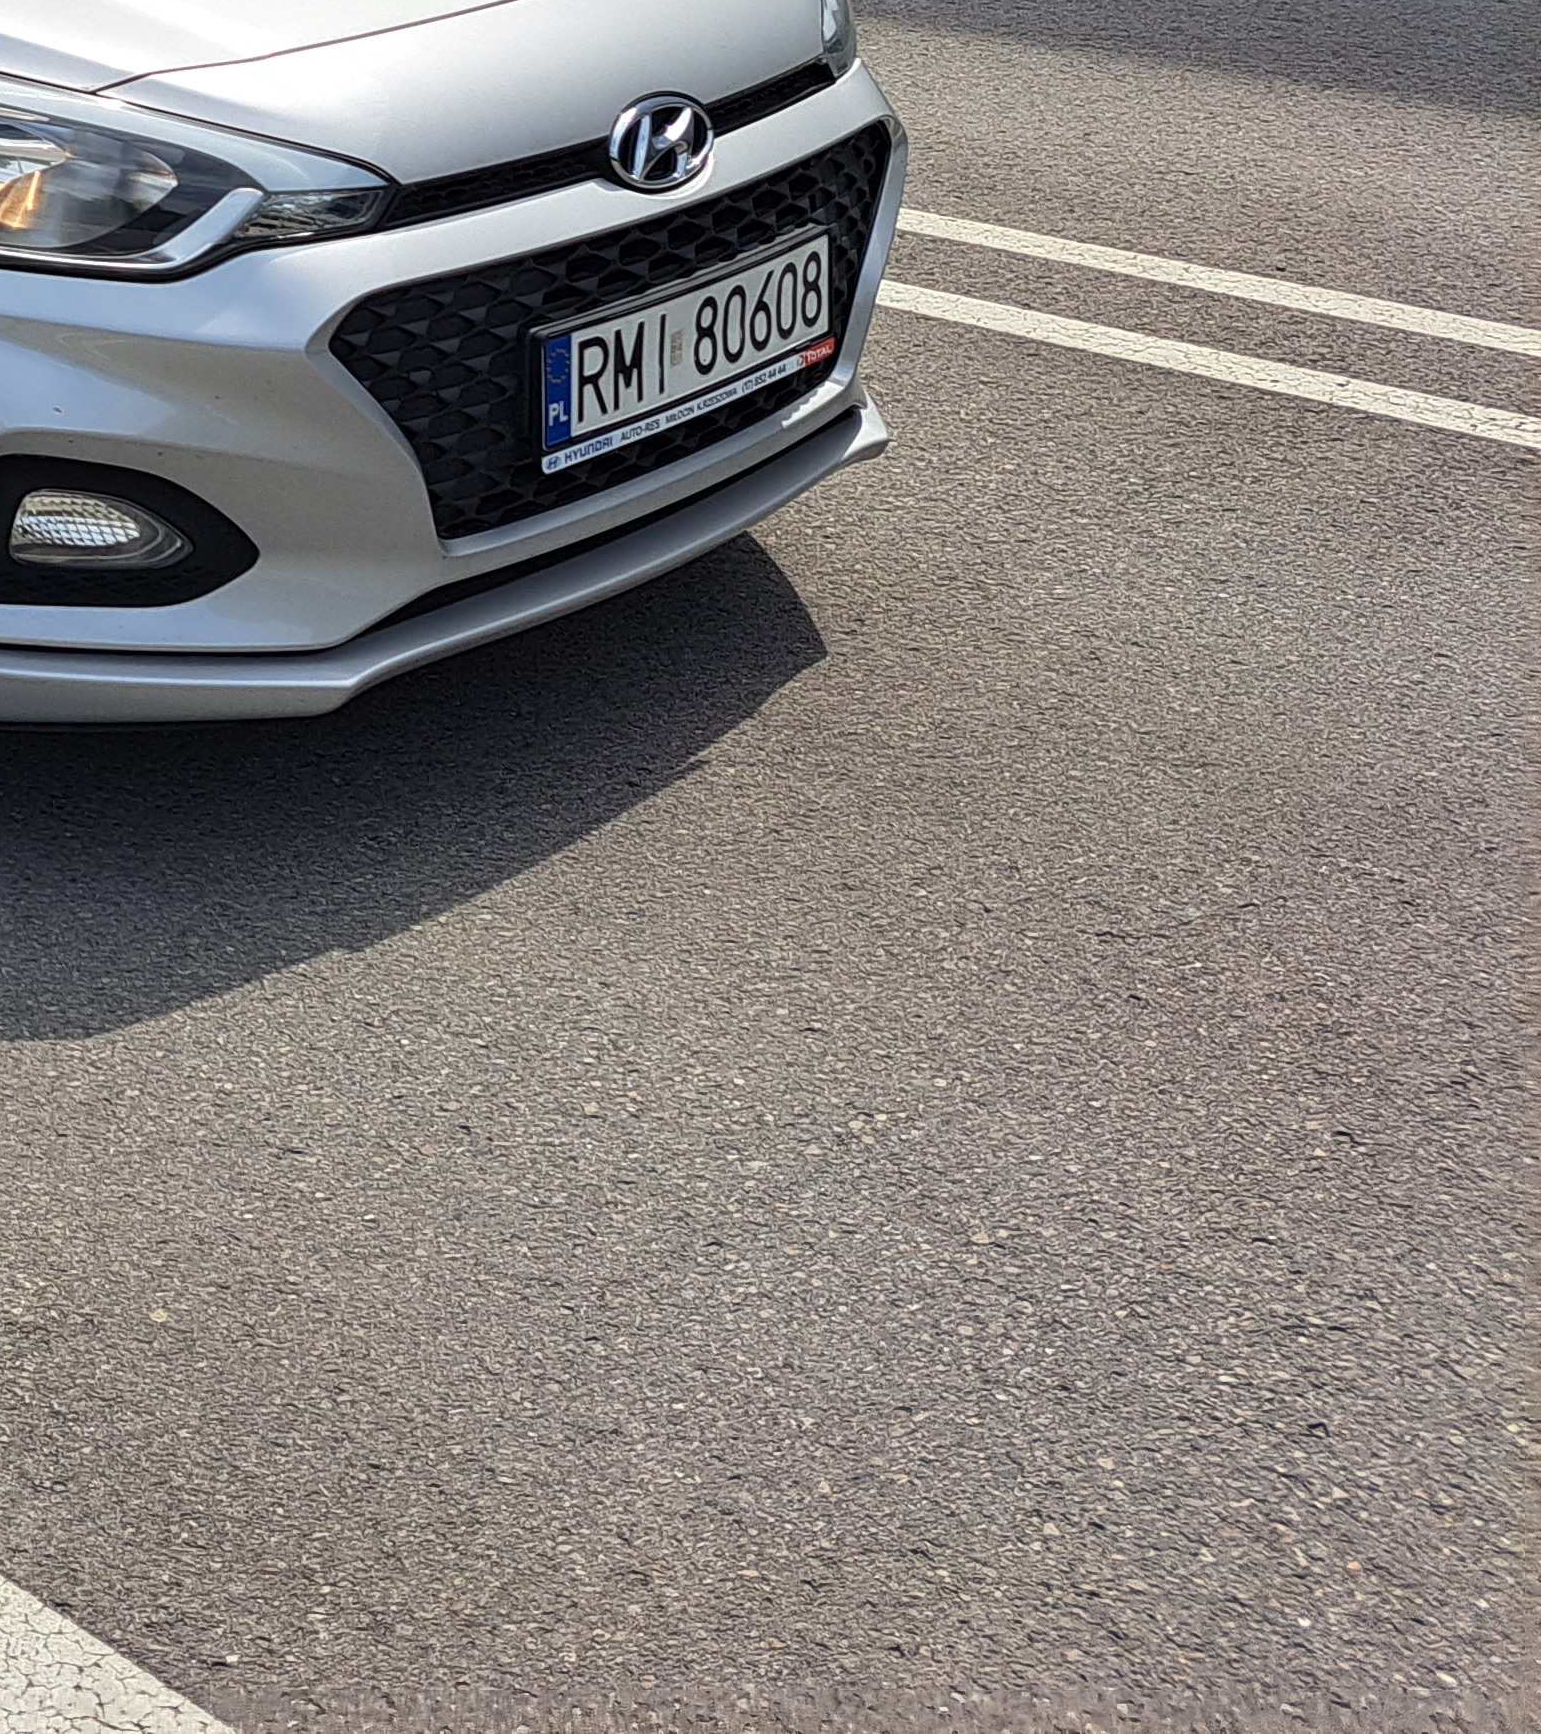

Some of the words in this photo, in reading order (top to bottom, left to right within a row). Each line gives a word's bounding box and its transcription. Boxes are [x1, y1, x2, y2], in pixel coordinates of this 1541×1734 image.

[577, 314, 667, 422] RMI
[693, 250, 822, 376] 80608
[806, 344, 833, 362] TOTAL
[547, 400, 569, 427] PL
[564, 436, 614, 465] HYUNDAI
